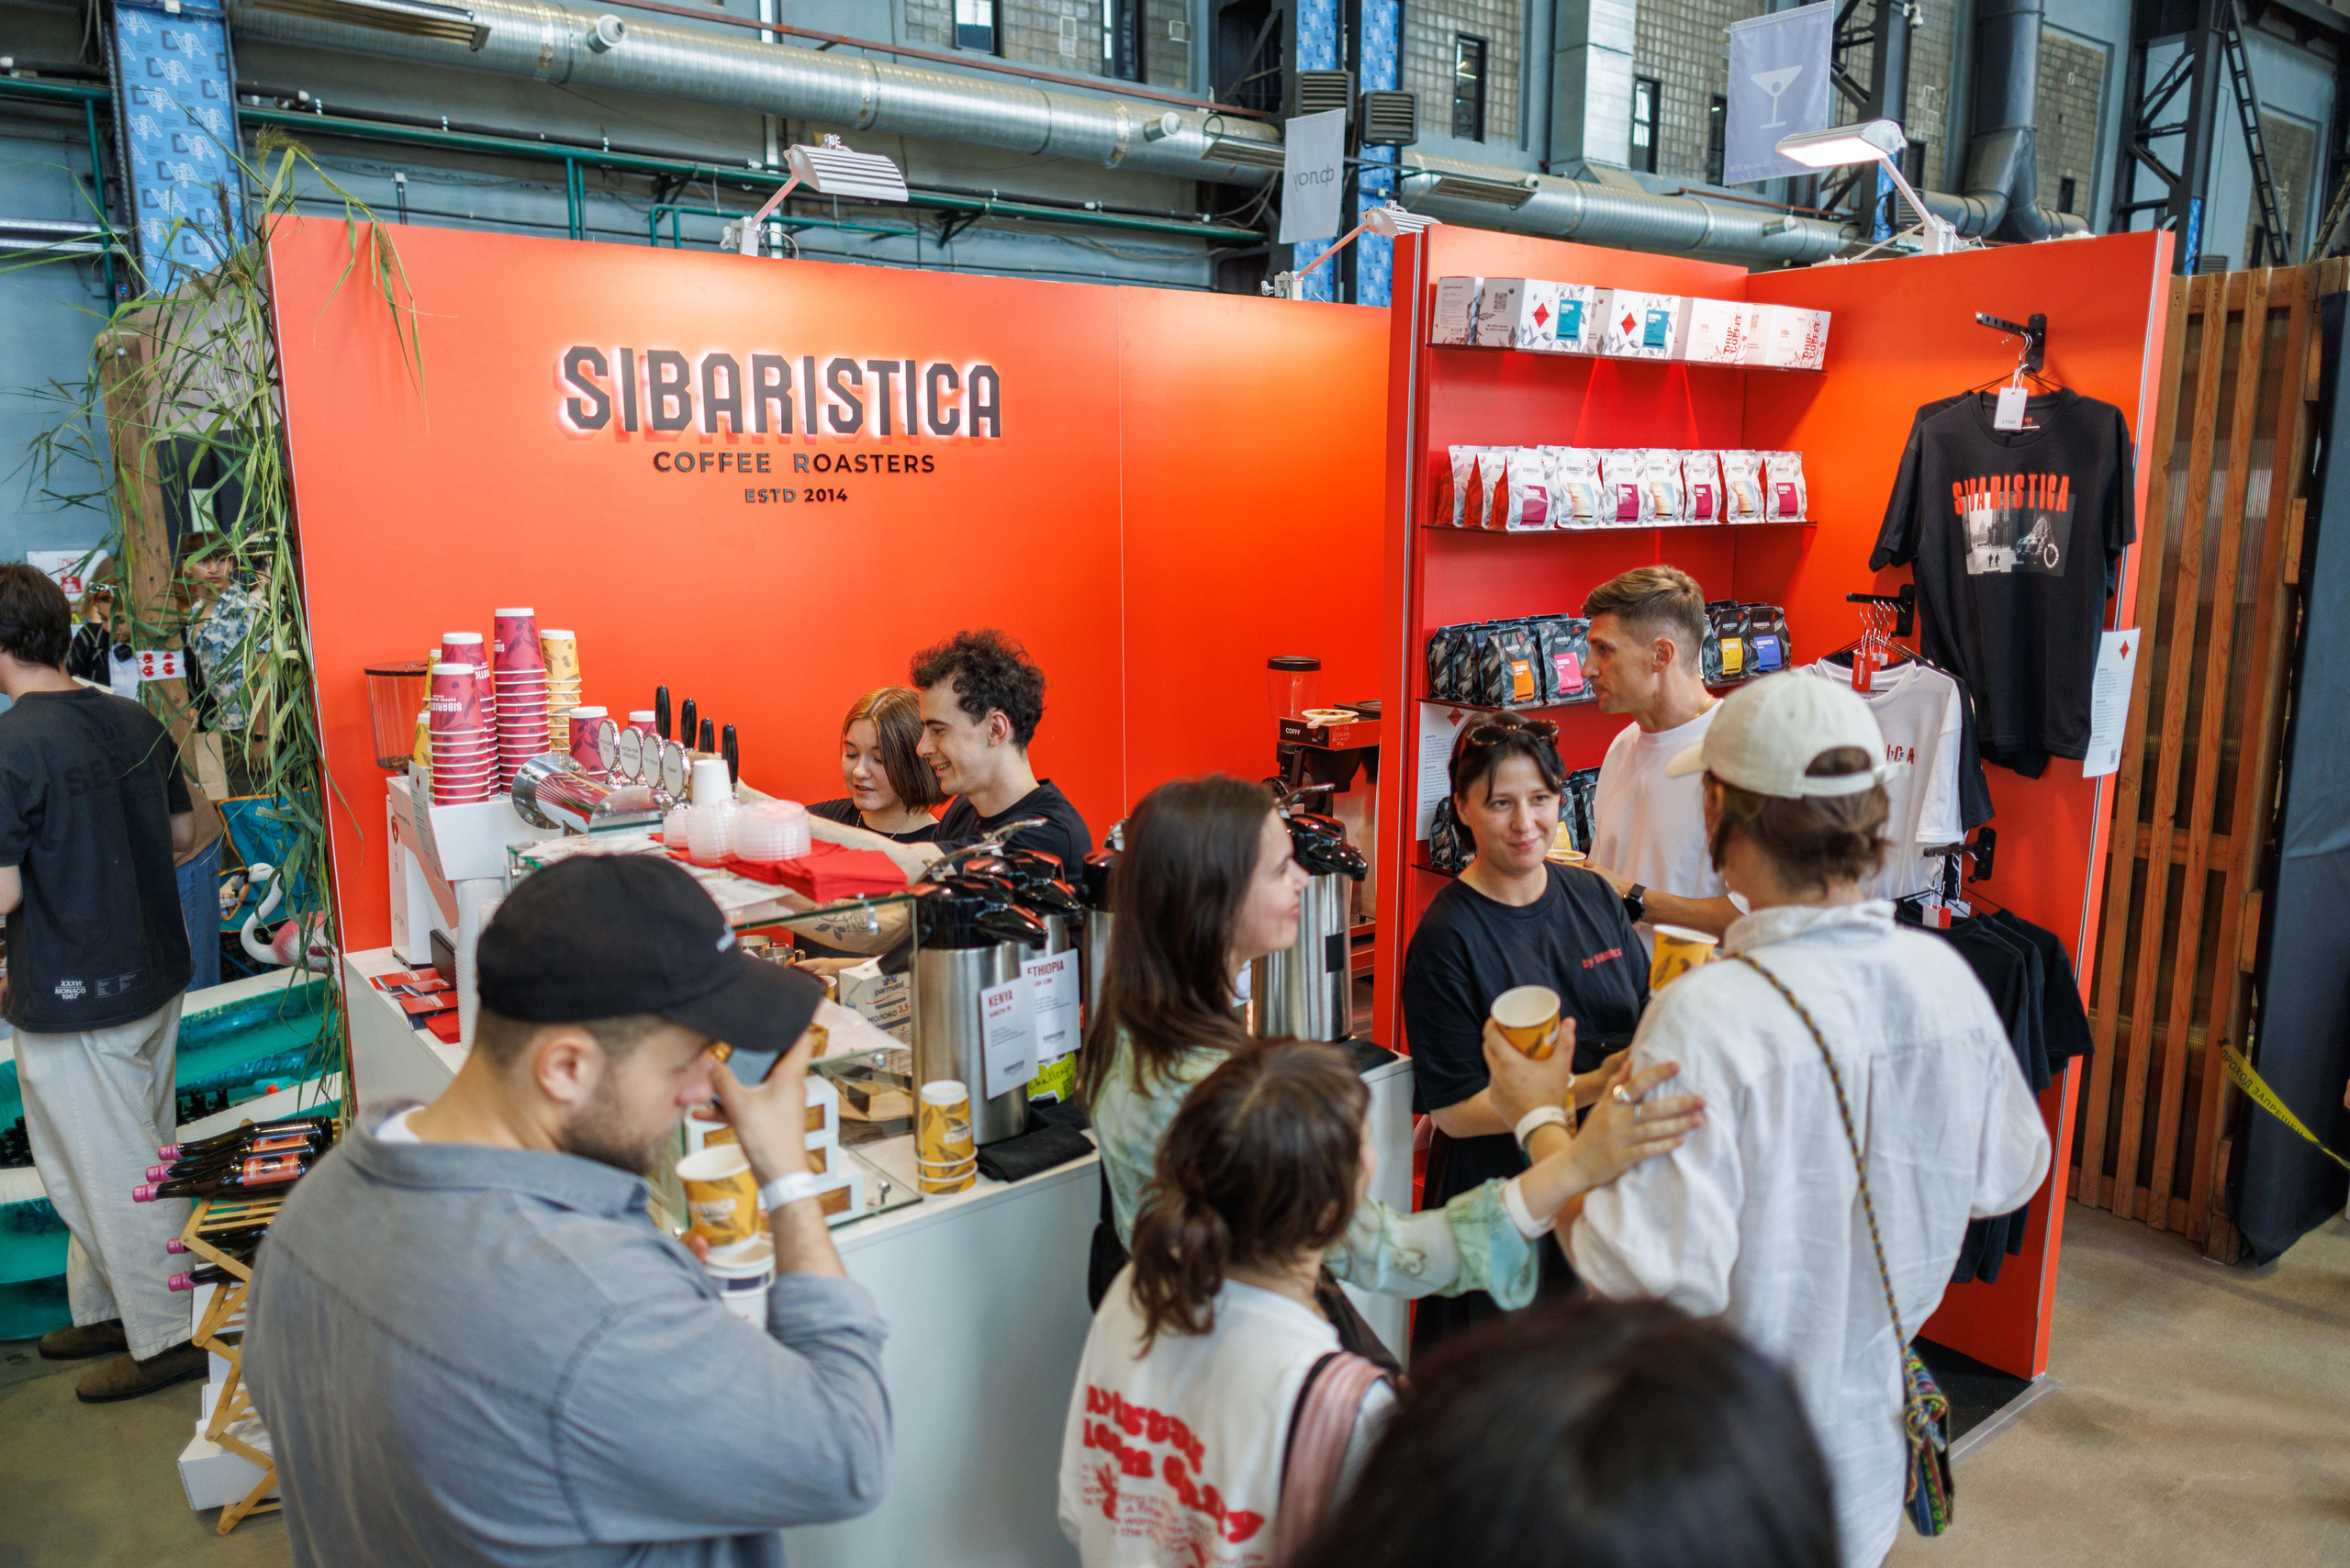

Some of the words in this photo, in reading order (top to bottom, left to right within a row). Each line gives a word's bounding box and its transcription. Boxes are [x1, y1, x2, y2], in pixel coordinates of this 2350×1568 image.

[1724, 326, 1733, 353] DRIP
[1731, 313, 1742, 353] COFFEE
[1802, 333, 1812, 358] DRIP
[1809, 319, 1821, 358] COFFEE
[564, 346, 1001, 438] SIBARISTICA
[653, 452, 772, 473] COFFEE
[794, 453, 935, 474] ROASTERS
[744, 488, 797, 504] ESTD
[803, 488, 848, 503] 2014
[874, 981, 905, 997] parmalat
[988, 990, 1013, 1008] KENYA
[2221, 1050, 2253, 1090] ПРОХОД
